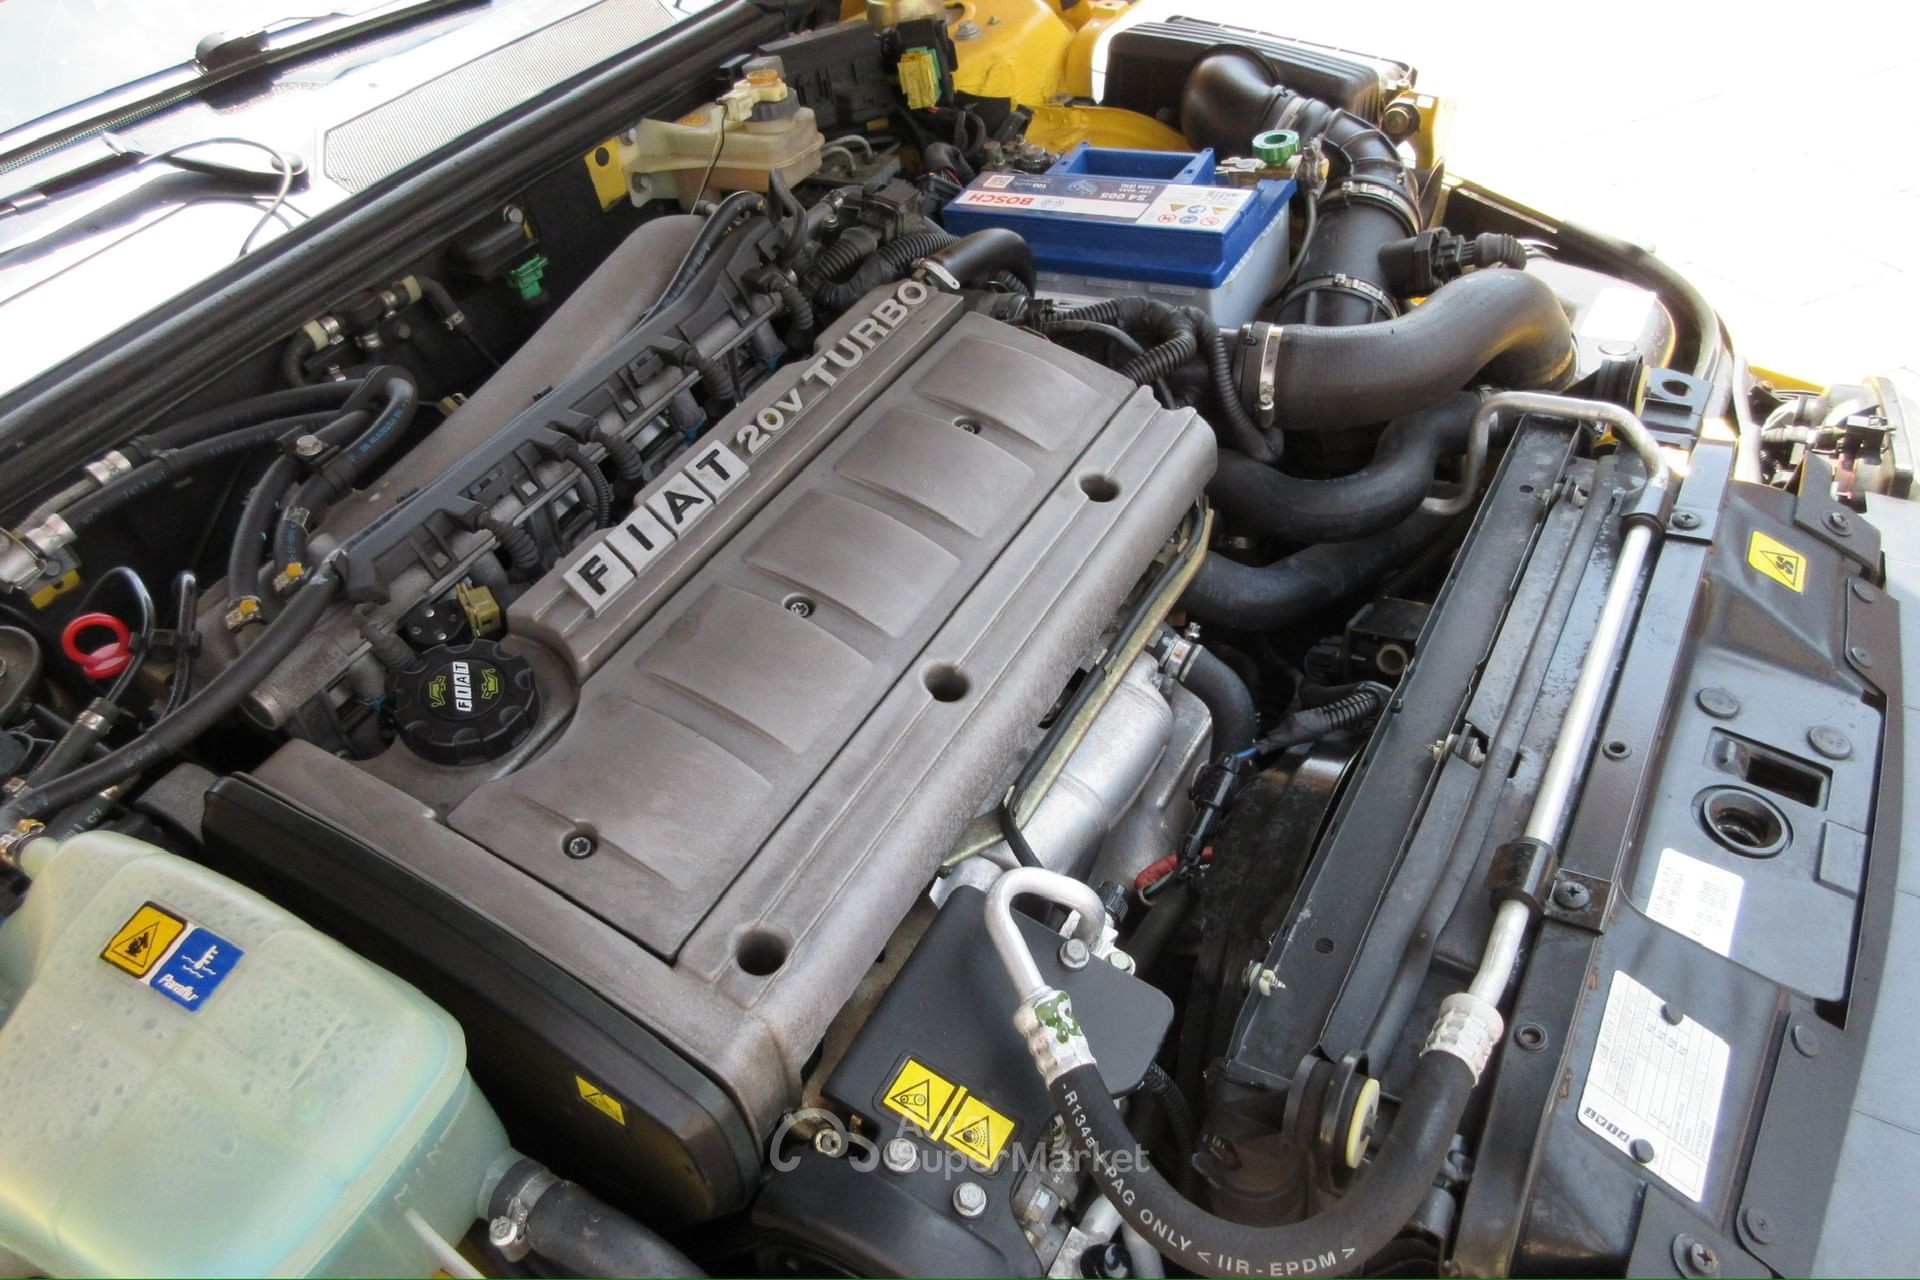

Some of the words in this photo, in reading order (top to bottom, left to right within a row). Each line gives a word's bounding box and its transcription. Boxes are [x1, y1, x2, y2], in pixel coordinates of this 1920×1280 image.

[968, 193, 1034, 206] BOSCH
[575, 447, 733, 597] FIAT
[802, 280, 929, 389] TURBO
[453, 661, 472, 712] FIAT
[1584, 1106, 1630, 1143] FIAT
[1106, 1165, 1136, 1206] PAG
[1140, 1208, 1193, 1252] ONLY
